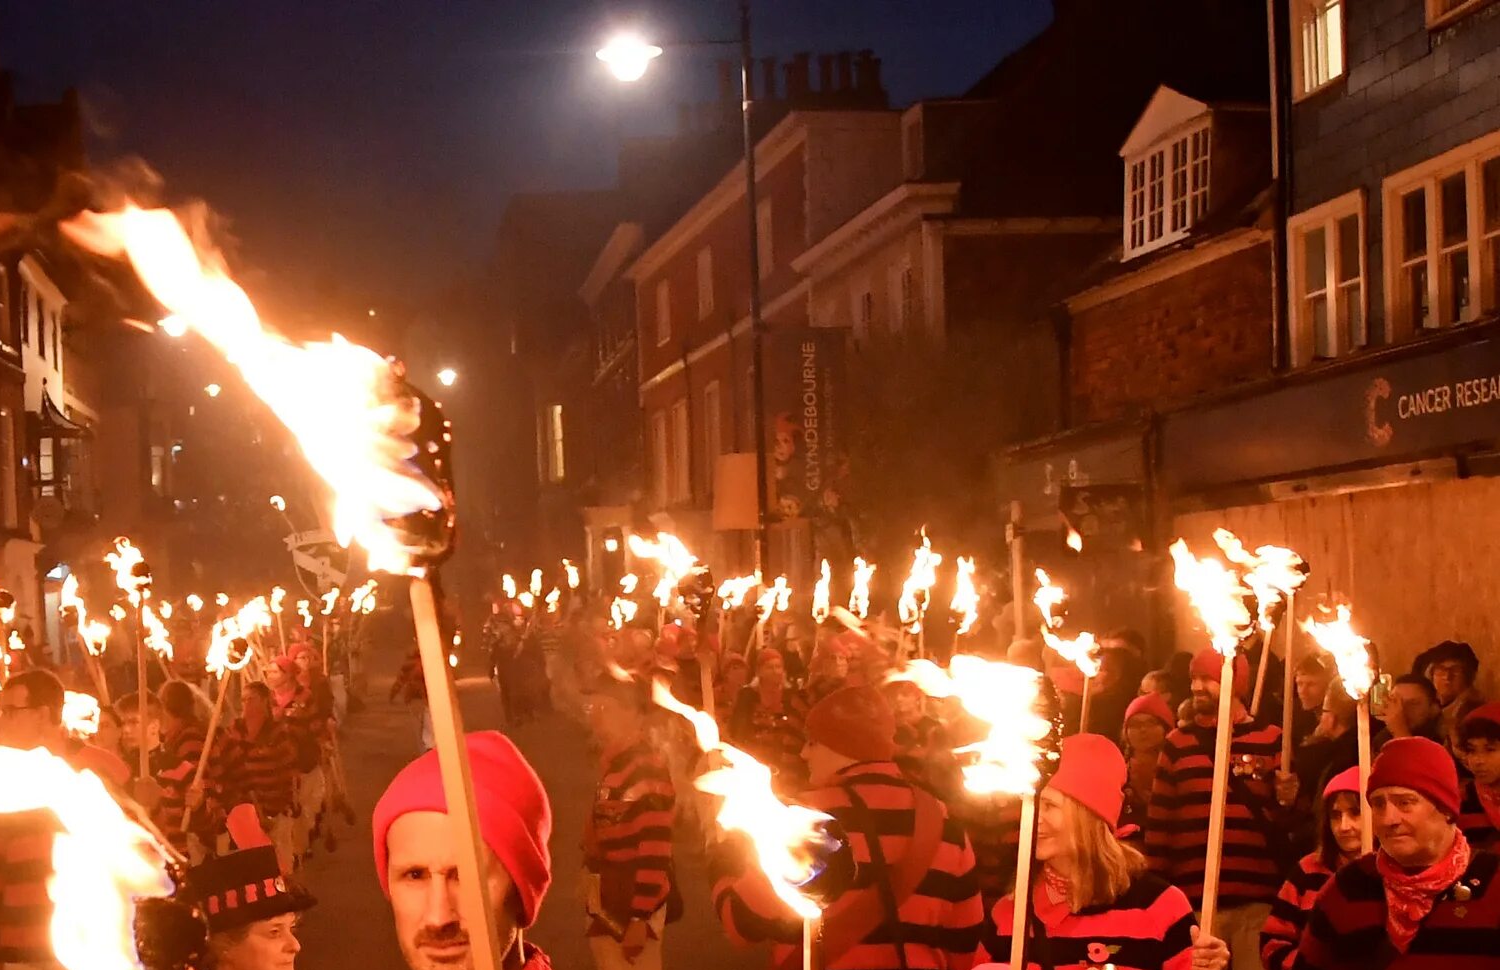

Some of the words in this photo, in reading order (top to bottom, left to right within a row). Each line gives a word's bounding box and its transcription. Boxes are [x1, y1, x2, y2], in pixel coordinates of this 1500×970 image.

[801, 341, 820, 491] GLYNDEBOURNE
[1397, 385, 1452, 420] CANCER
[1455, 374, 1500, 408] RESEA
